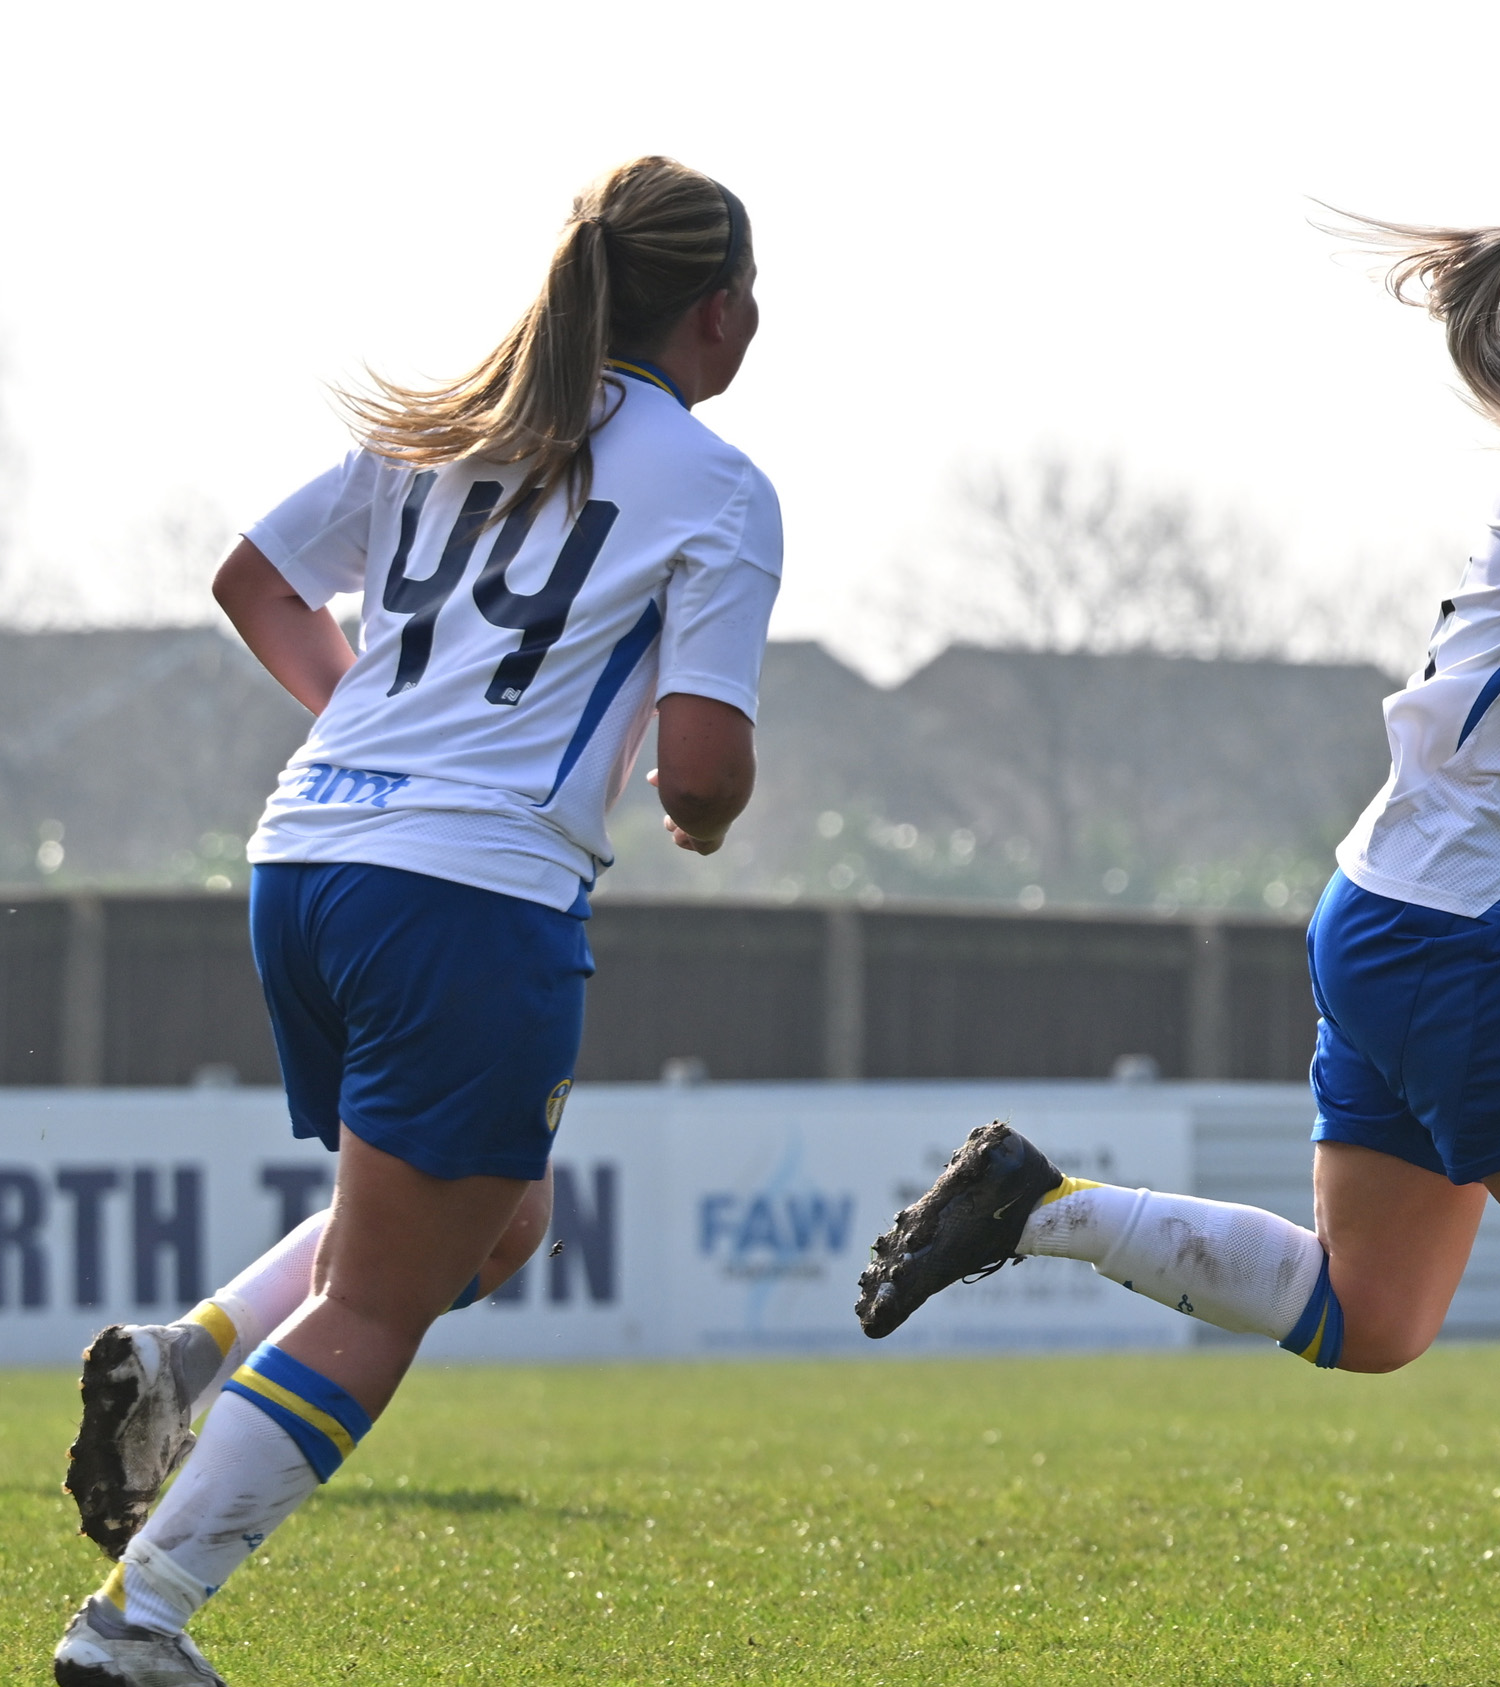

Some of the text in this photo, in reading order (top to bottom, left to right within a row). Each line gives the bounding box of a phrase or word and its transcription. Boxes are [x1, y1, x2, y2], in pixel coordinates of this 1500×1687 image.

[382, 468, 621, 706] 44
[260, 1163, 620, 1308] TN
[699, 1193, 854, 1255] FAW
